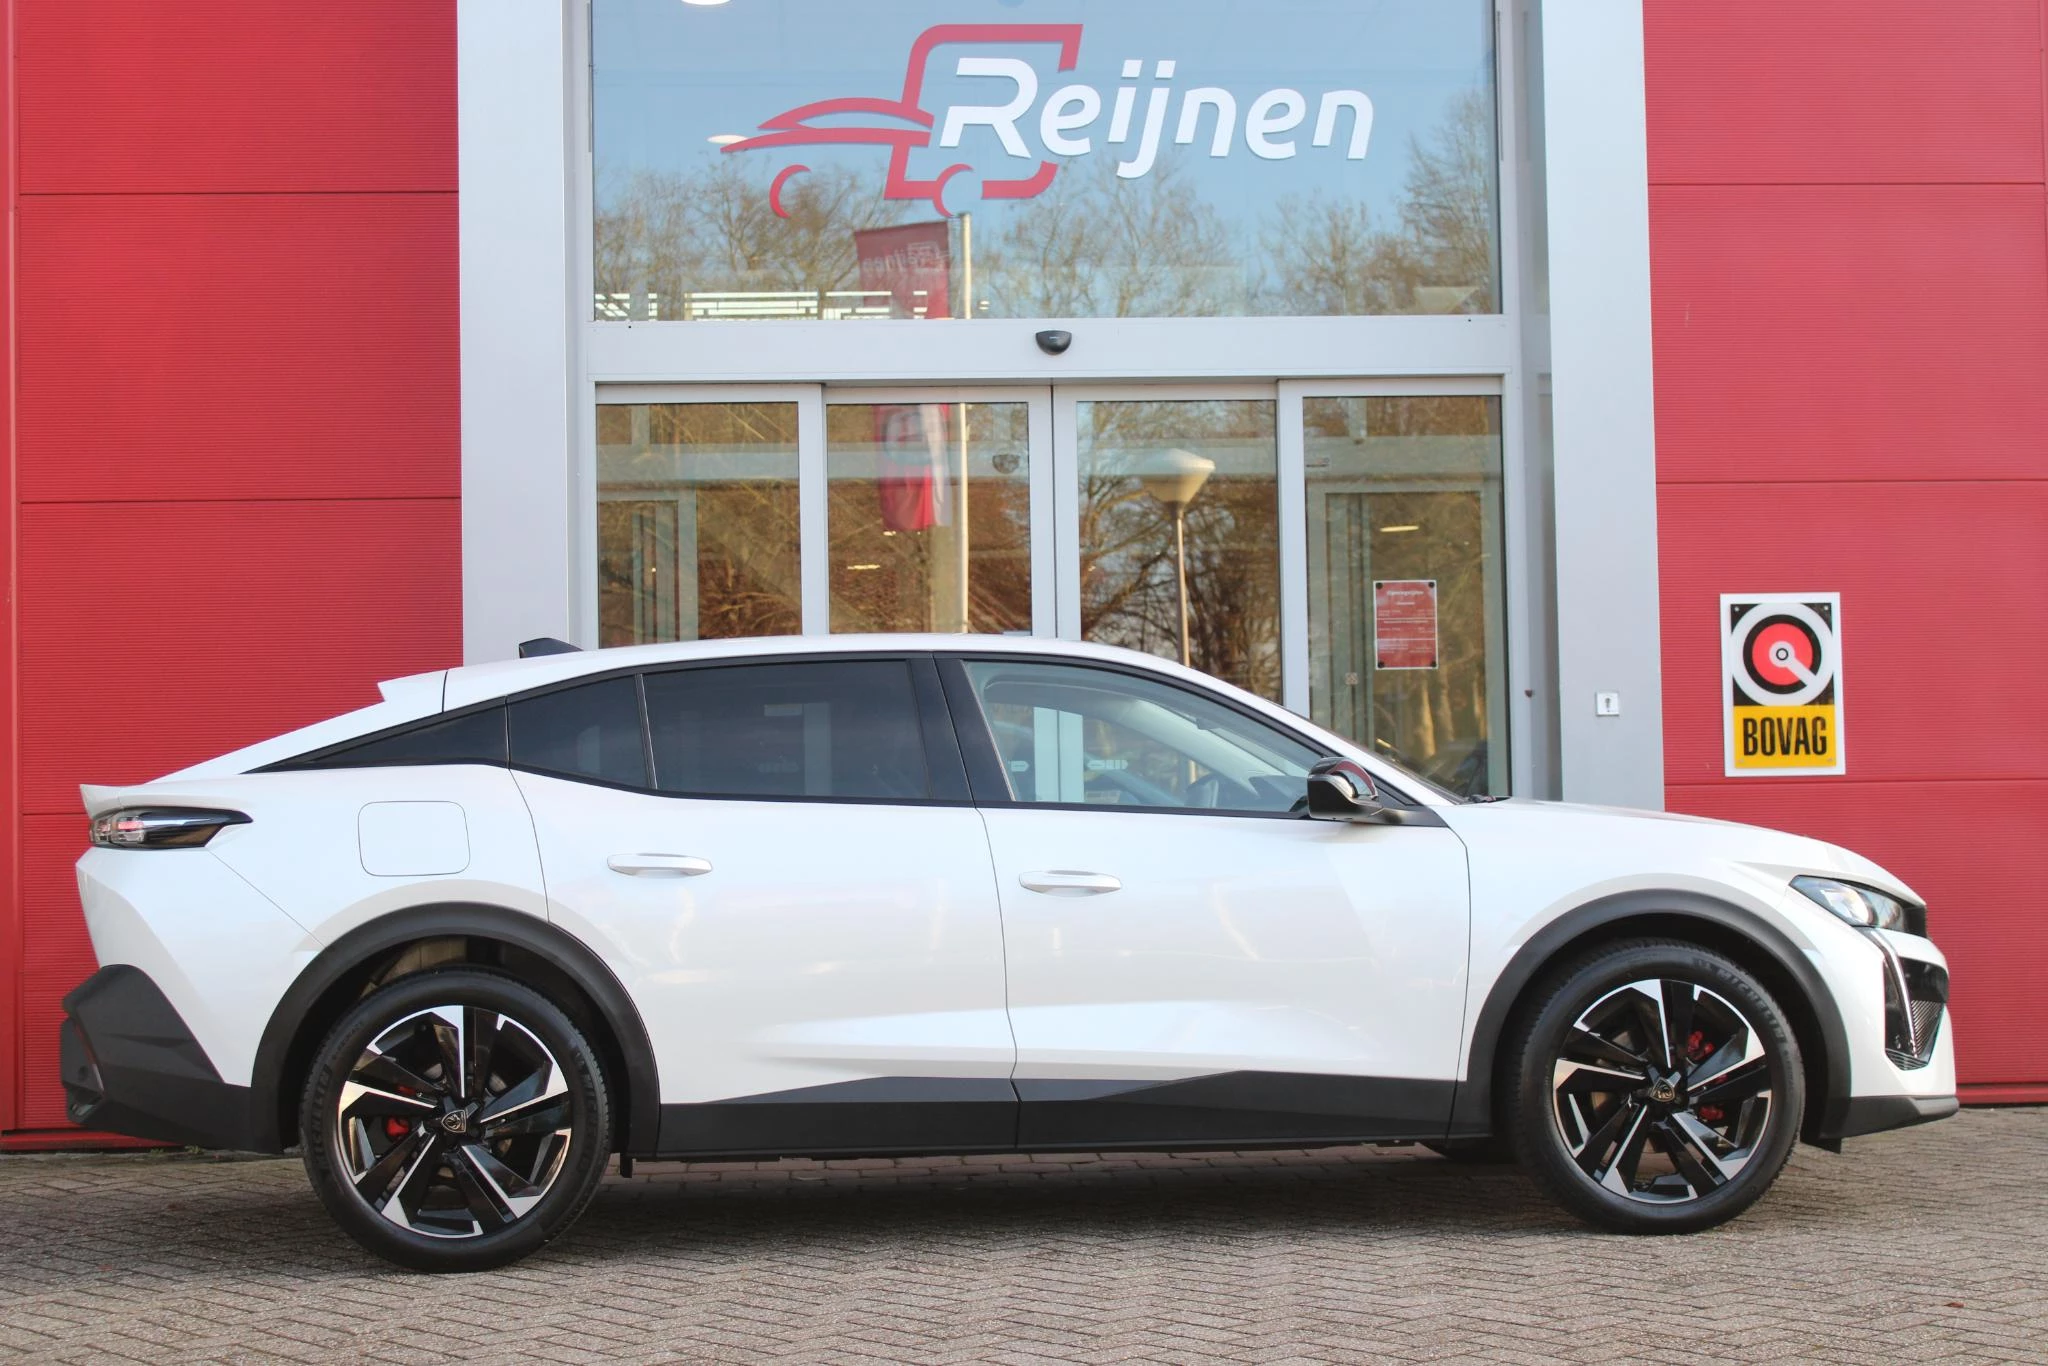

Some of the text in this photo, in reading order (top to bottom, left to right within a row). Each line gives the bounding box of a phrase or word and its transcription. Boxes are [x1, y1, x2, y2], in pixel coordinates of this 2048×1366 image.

[939, 57, 1374, 179] Reijnen
[1743, 716, 1827, 756] BOVAG
[1715, 967, 1787, 1039] MICHELIN
